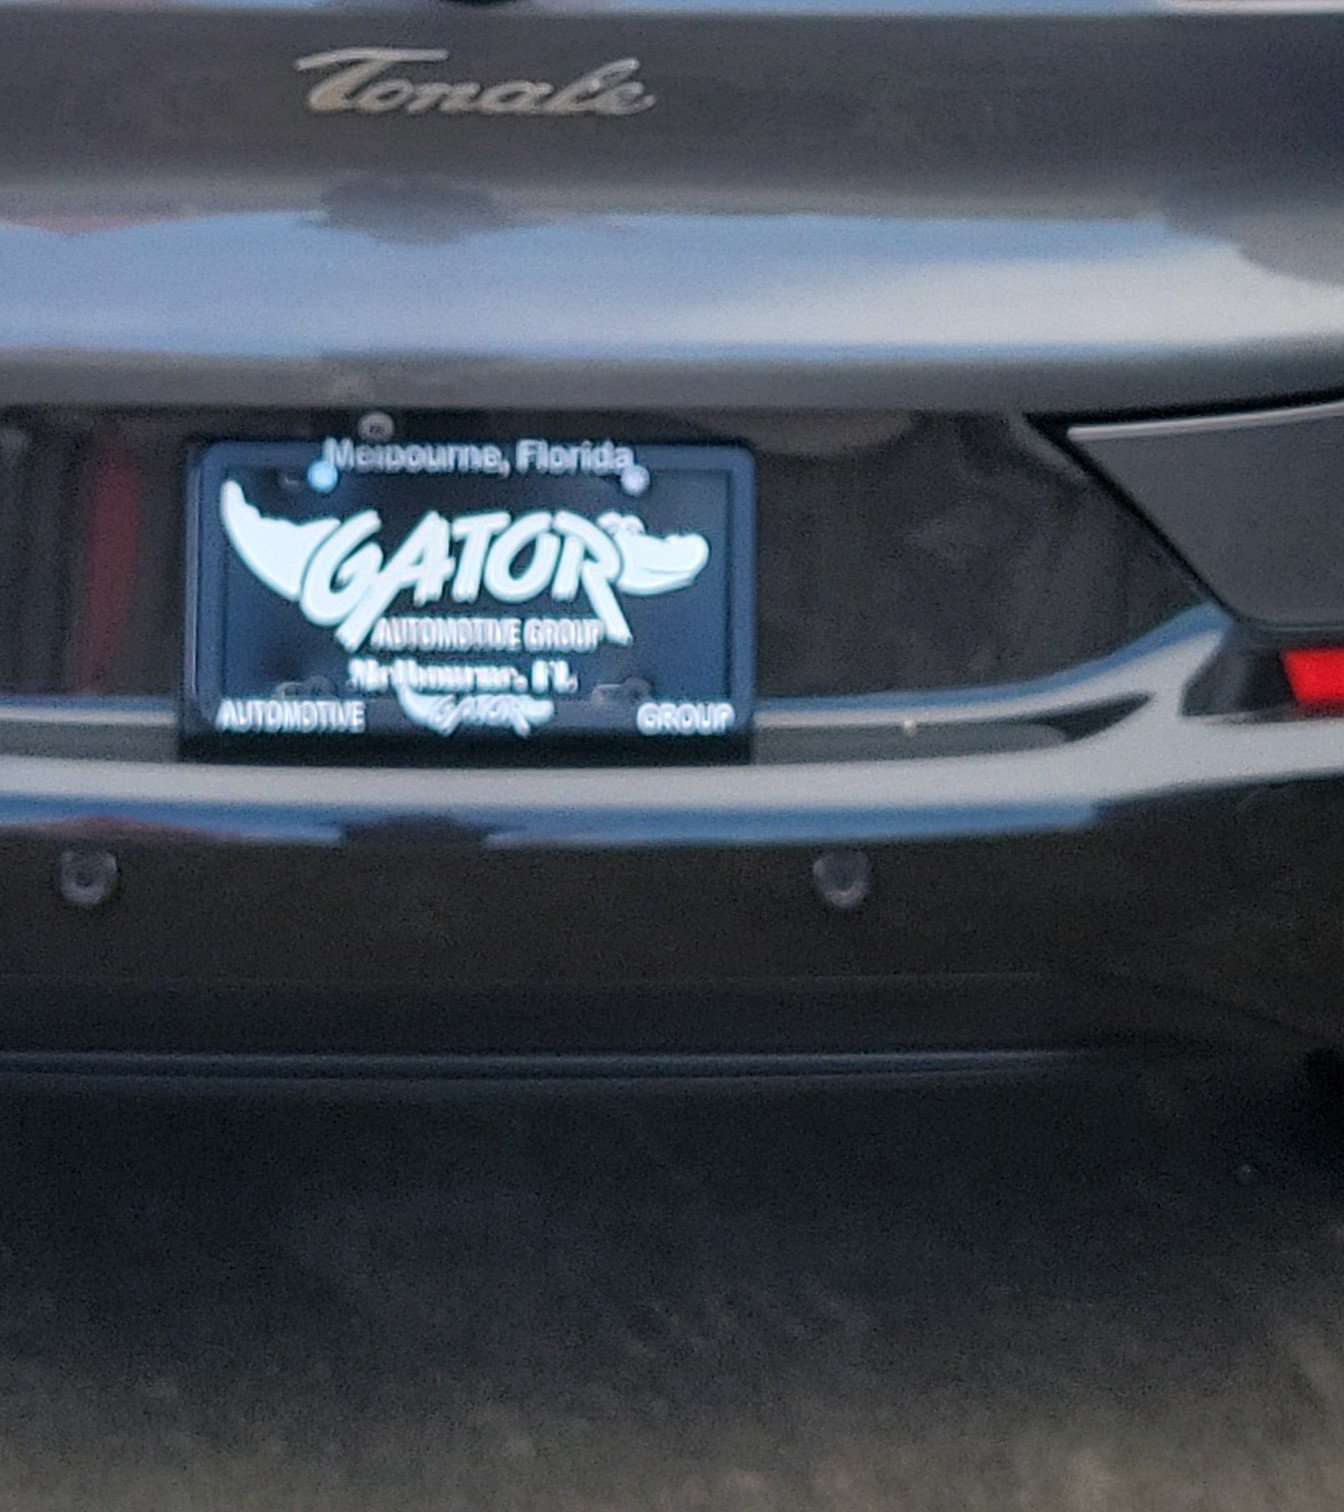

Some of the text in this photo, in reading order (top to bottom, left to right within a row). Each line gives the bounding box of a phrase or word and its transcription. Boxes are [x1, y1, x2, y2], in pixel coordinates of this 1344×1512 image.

[294, 47, 656, 115] Tonale
[516, 439, 635, 474] Florida
[300, 510, 632, 651] GATOR
[371, 617, 602, 652] AUTOMOTIVE GROUP
[216, 698, 365, 733] AUTOMOTIVE
[636, 702, 735, 736] GROUP
